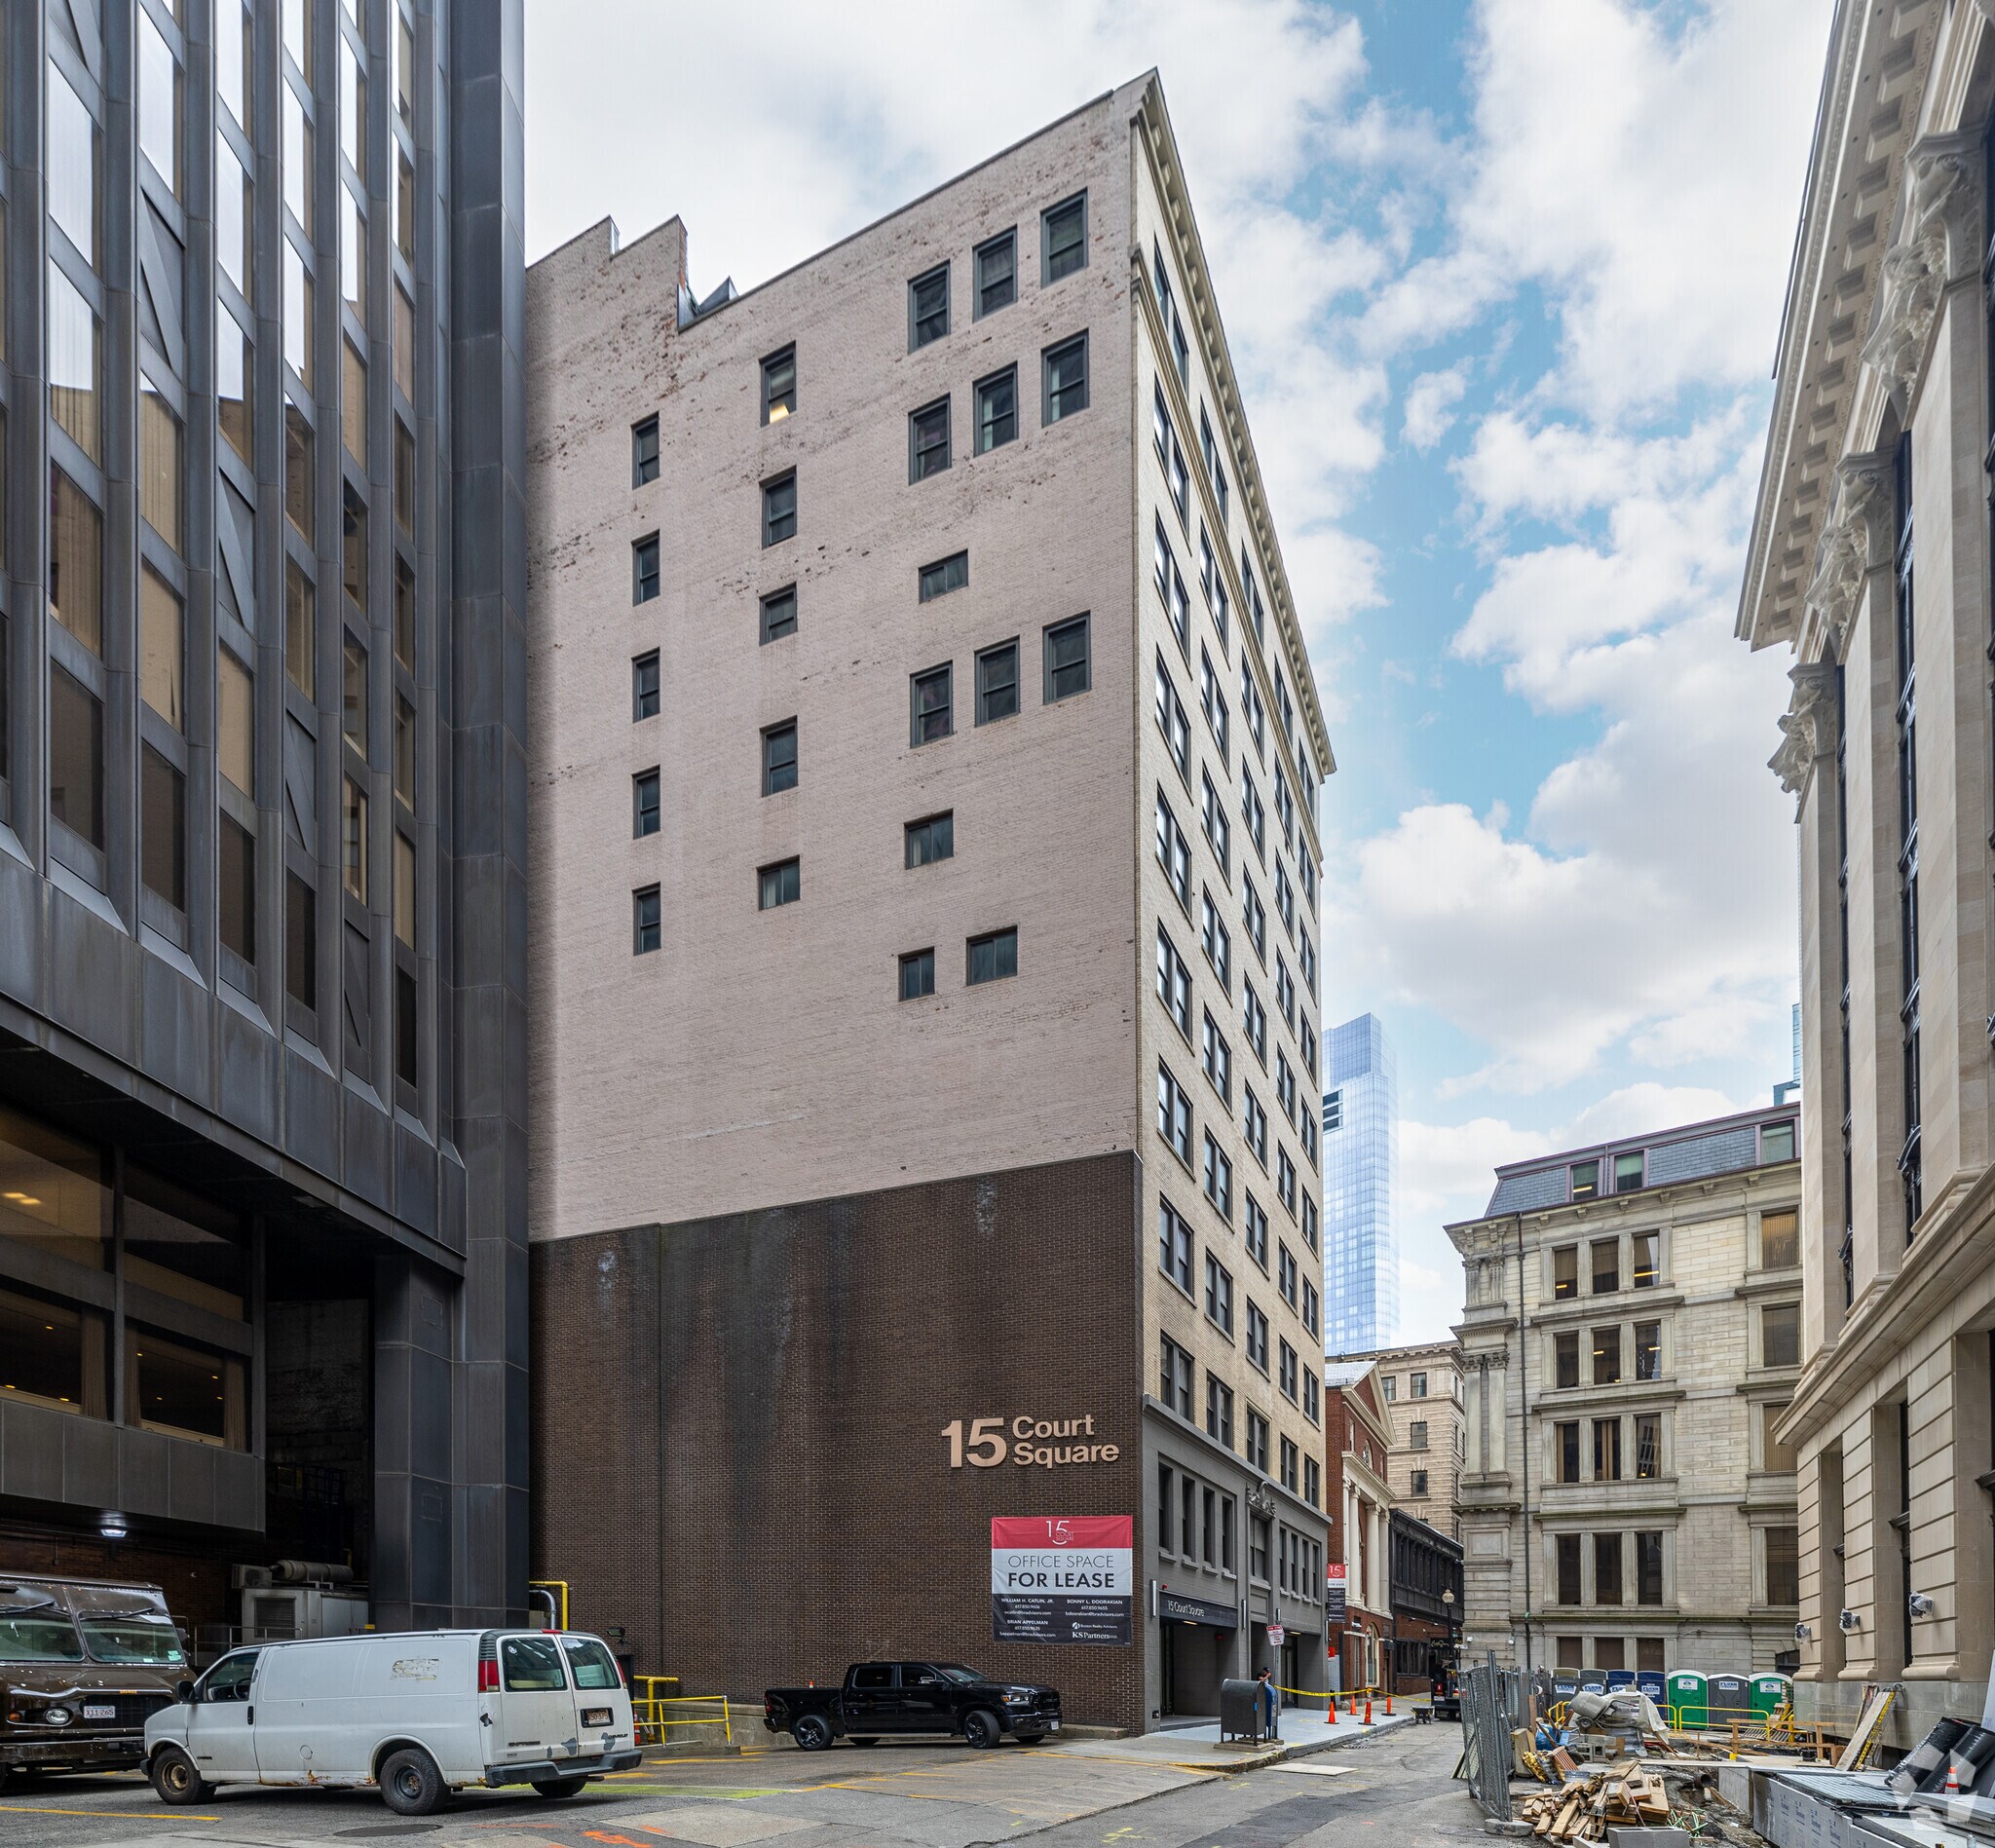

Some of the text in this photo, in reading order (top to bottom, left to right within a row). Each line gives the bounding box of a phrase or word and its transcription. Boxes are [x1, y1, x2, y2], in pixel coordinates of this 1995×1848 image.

[1012, 1414, 1095, 1439] Court
[941, 1416, 1007, 1468] 15
[1013, 1443, 1119, 1469] Square
[1045, 1520, 1071, 1545] 15
[1007, 1555, 1114, 1568] OFFICE SPACE
[1007, 1572, 1114, 1589] FOR LEASE
